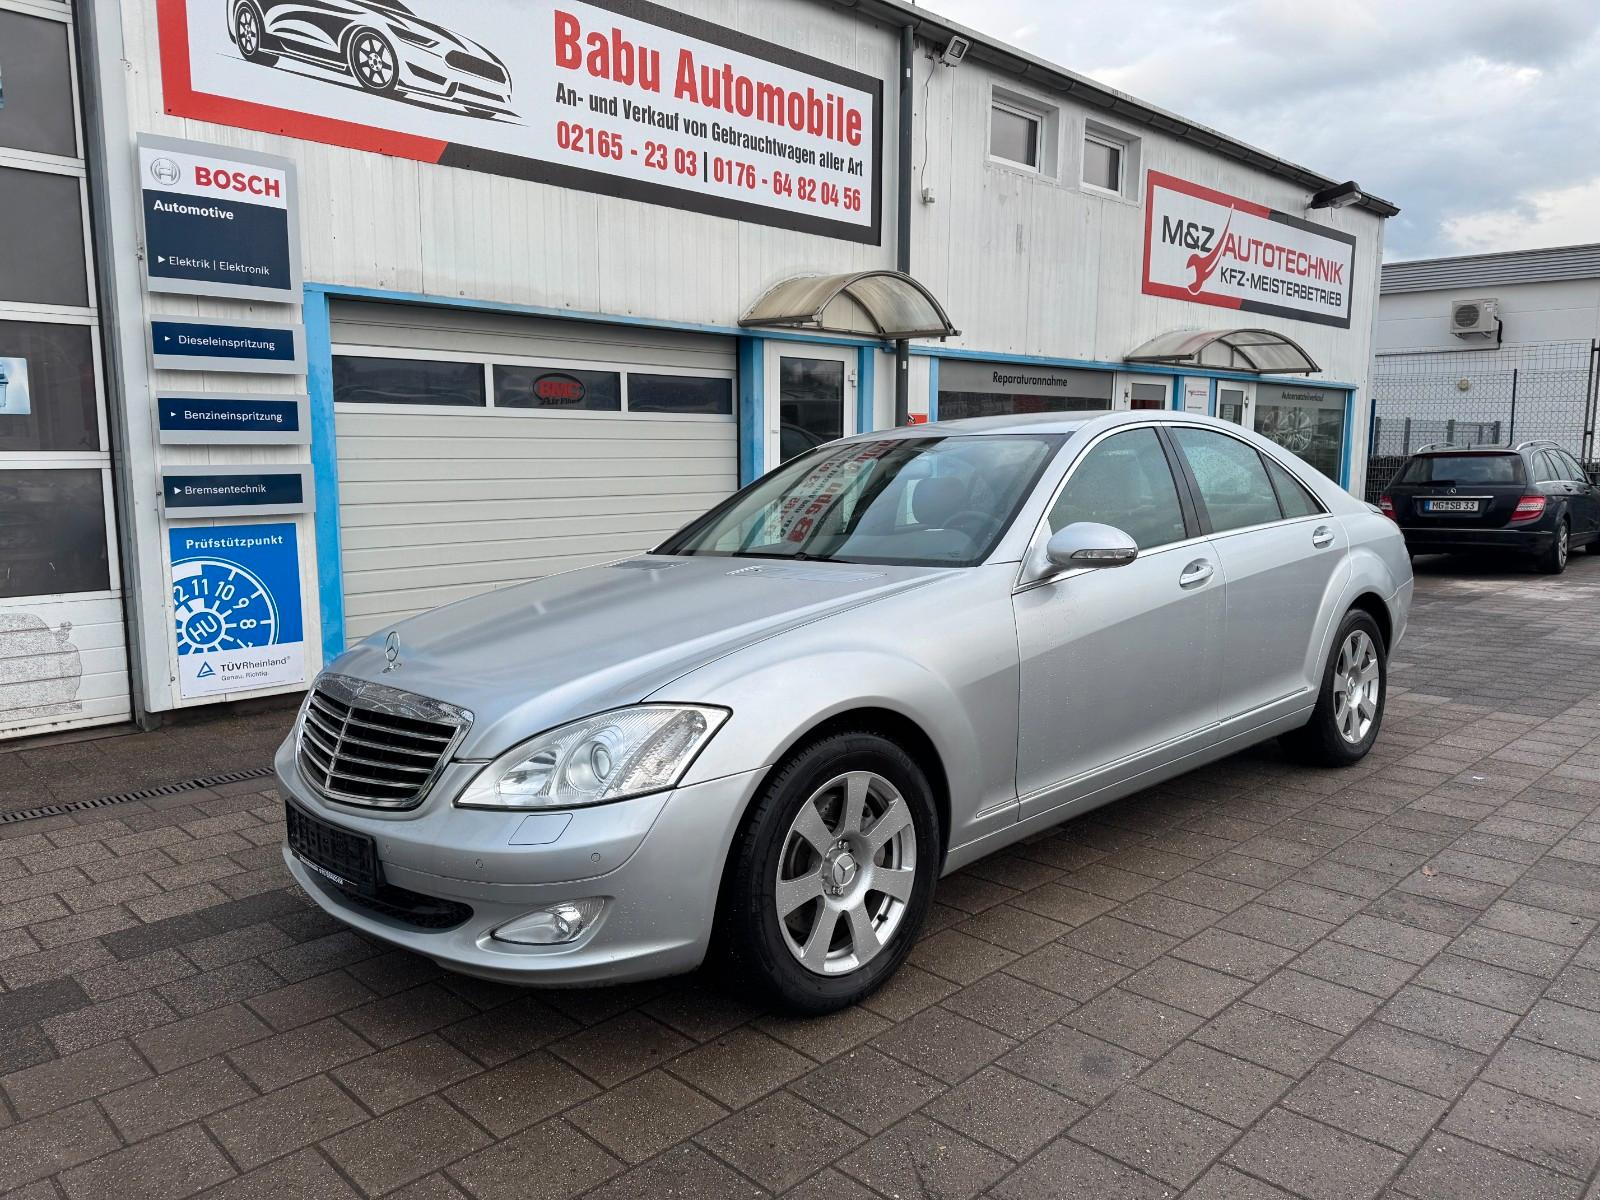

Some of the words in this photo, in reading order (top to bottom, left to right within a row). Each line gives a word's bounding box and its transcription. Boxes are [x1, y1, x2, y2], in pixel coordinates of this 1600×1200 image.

[554, 9, 660, 93] Babu
[673, 48, 862, 146] Automobile
[555, 82, 584, 107] An-
[589, 94, 618, 117] und
[623, 98, 679, 132] Verkauf
[683, 117, 707, 139] von
[711, 122, 815, 165] Gebrauchtwagen
[819, 151, 844, 172] aller
[847, 157, 863, 177] Art
[556, 120, 623, 161] 02165
[644, 140, 668, 170] 23
[674, 147, 697, 177] 03
[713, 156, 756, 189] 0176
[773, 170, 792, 198] 64
[797, 176, 816, 202] 82
[821, 181, 840, 207] 04
[843, 186, 861, 212] 56
[195, 166, 280, 198] BOSCH
[153, 200, 234, 220] Automotive
[1162, 215, 1215, 252] M&Z
[1222, 232, 1344, 285] AUTOTECHNIK
[169, 256, 210, 269] Elektrik
[219, 261, 270, 276] Elektronik
[178, 335, 275, 351] Dieseleinspritzung
[992, 371, 1068, 387] Reparaturannahme
[184, 410, 283, 423] Benzineinspritzung
[185, 484, 267, 495] Bremsentechnik
[1463, 502, 1475, 510] 33
[185, 535, 283, 549] Prüfstützpunkt
[191, 578, 208, 596] 11
[215, 581, 235, 600] 10
[232, 597, 249, 609] 9
[188, 615, 218, 642] HU
[239, 618, 257, 630] 8
